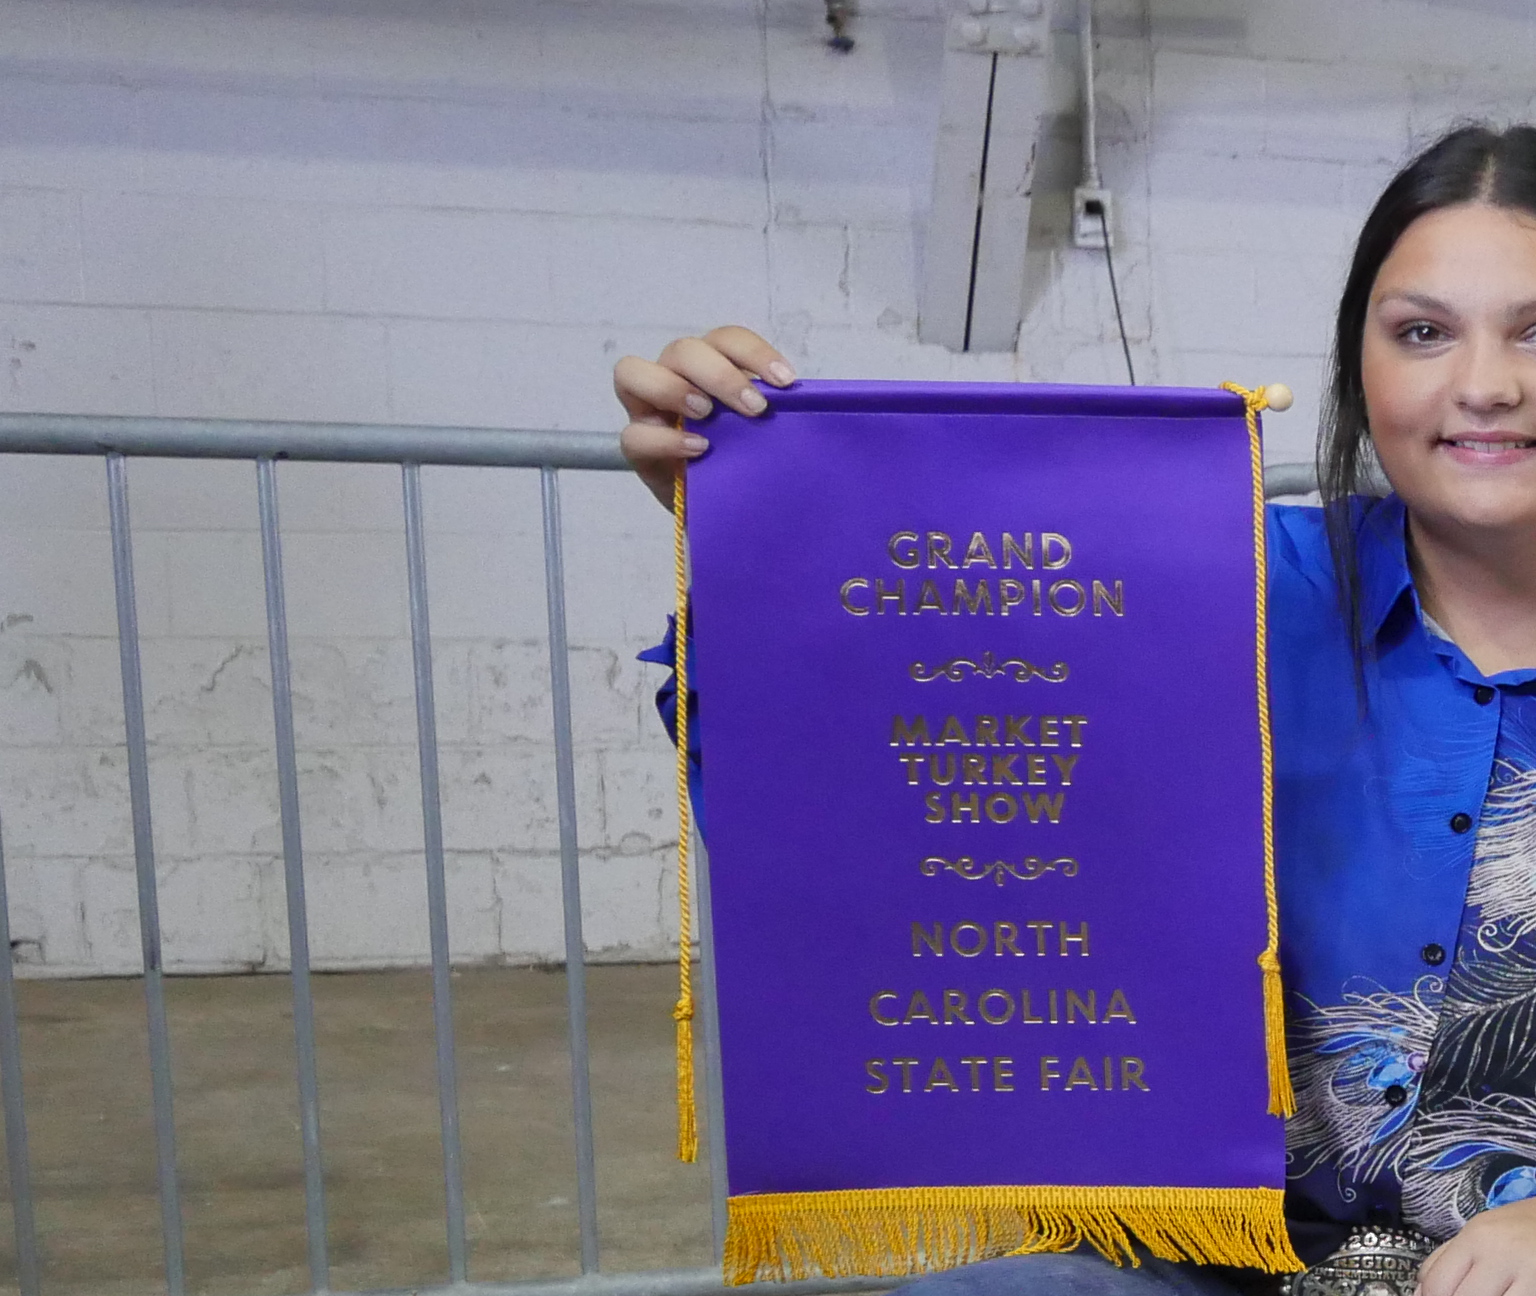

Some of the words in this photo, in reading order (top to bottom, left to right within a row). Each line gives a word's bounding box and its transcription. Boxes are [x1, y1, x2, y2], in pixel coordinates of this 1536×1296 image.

[888, 530, 1072, 570] GRAND
[840, 577, 1124, 617] CHAMPION
[889, 714, 1088, 748] MARKET
[899, 753, 1080, 786] TURKEY
[924, 792, 1065, 824] SHOW
[911, 920, 1090, 957] NORTH
[868, 987, 1137, 1026] CAROLINA
[865, 1056, 1015, 1094] STATE
[1039, 1055, 1151, 1092] FAIR
[1347, 1232, 1408, 1249] 2022
[1315, 1267, 1405, 1281] INTERMEDIATE
[1333, 1256, 1411, 1270] REGION
